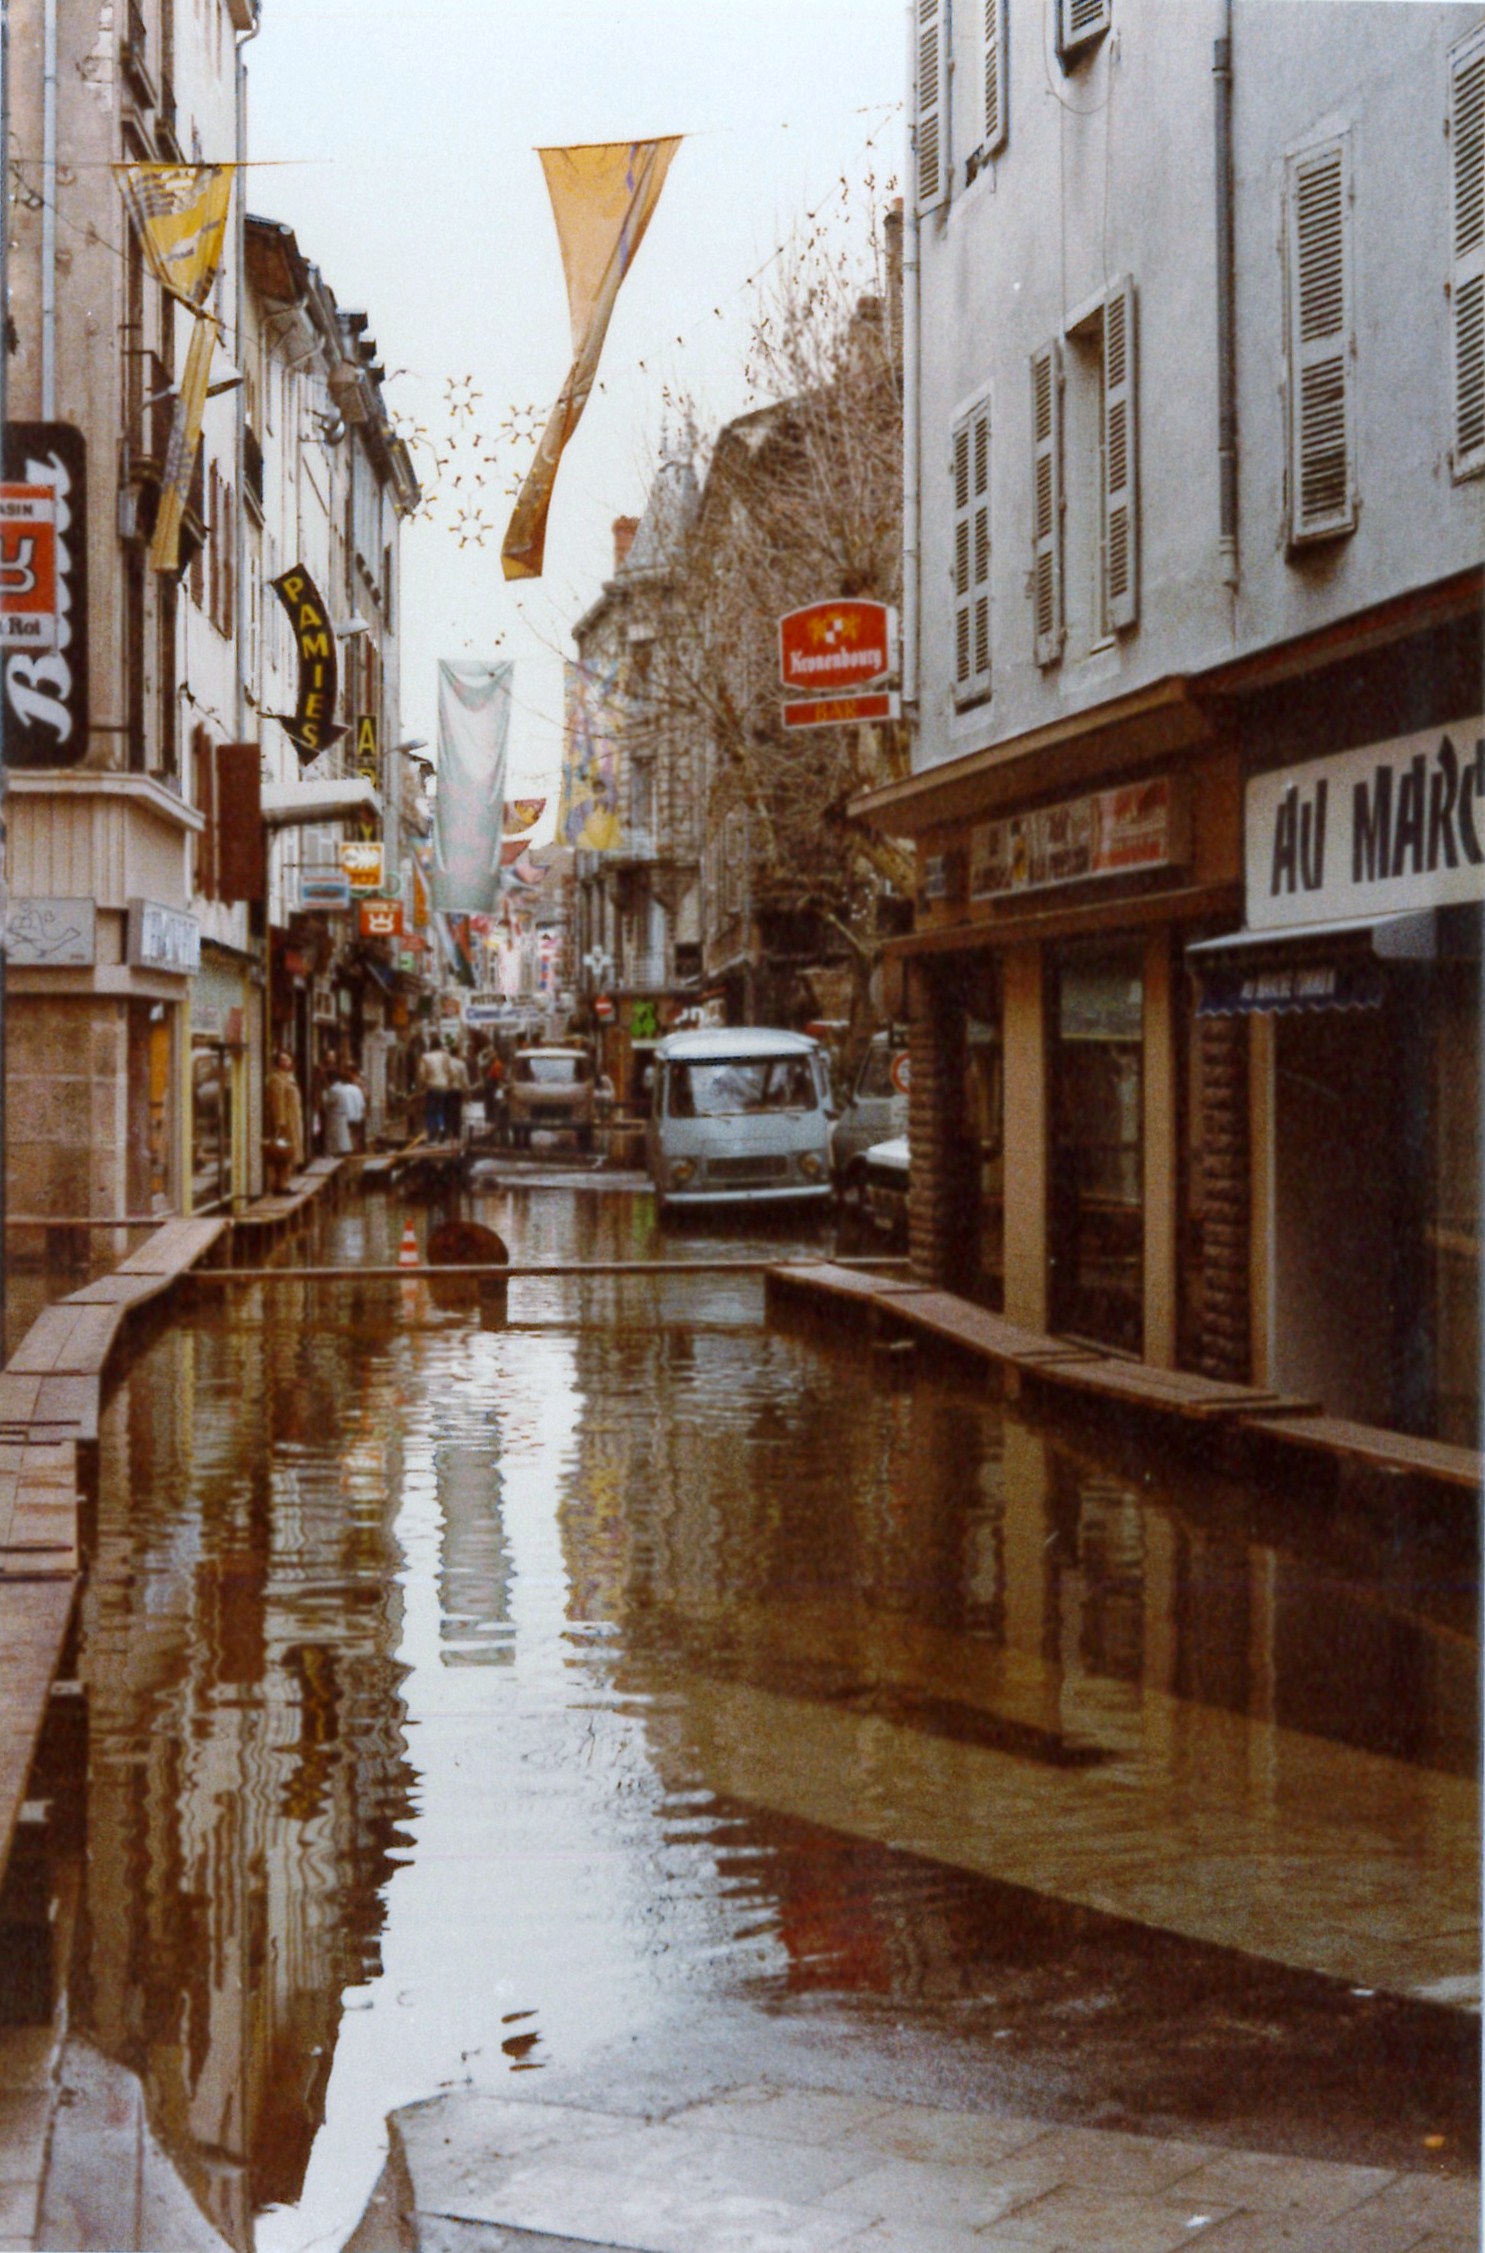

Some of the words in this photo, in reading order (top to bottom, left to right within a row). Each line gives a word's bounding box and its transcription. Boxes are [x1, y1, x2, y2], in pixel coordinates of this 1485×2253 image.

[282, 576, 328, 749] PAMIES
[789, 646, 882, 675] Kronenbourg
[814, 699, 857, 723] BAR
[1270, 779, 1328, 896] AU
